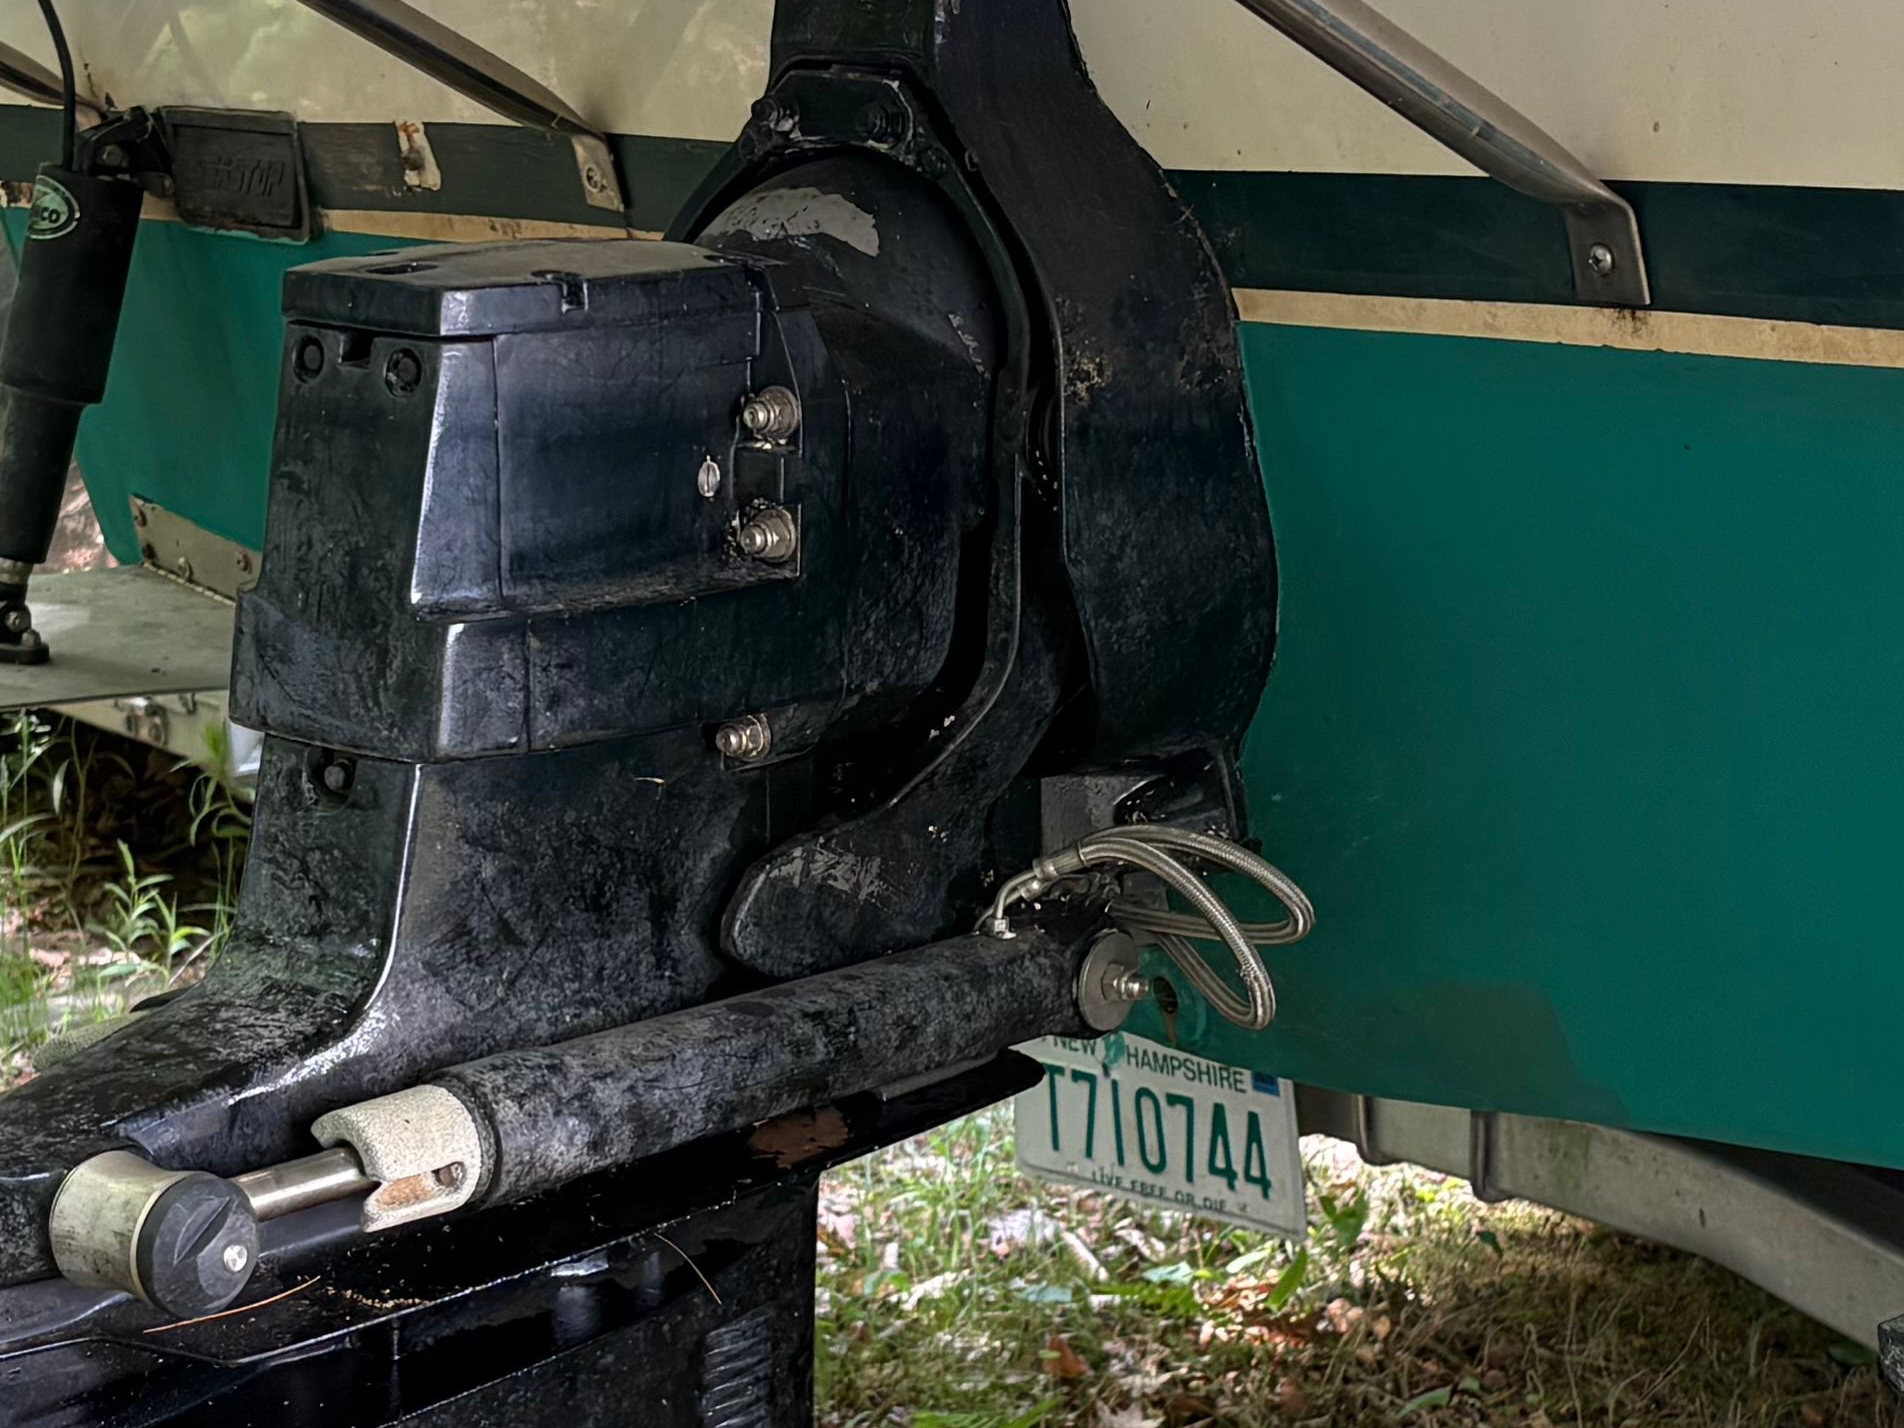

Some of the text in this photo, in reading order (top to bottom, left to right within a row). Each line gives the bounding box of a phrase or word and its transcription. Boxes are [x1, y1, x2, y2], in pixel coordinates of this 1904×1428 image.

[1053, 1036, 1096, 1056] NEW
[1126, 1044, 1248, 1093] HAMPSHIRE
[1042, 1061, 1272, 1200] T710744
